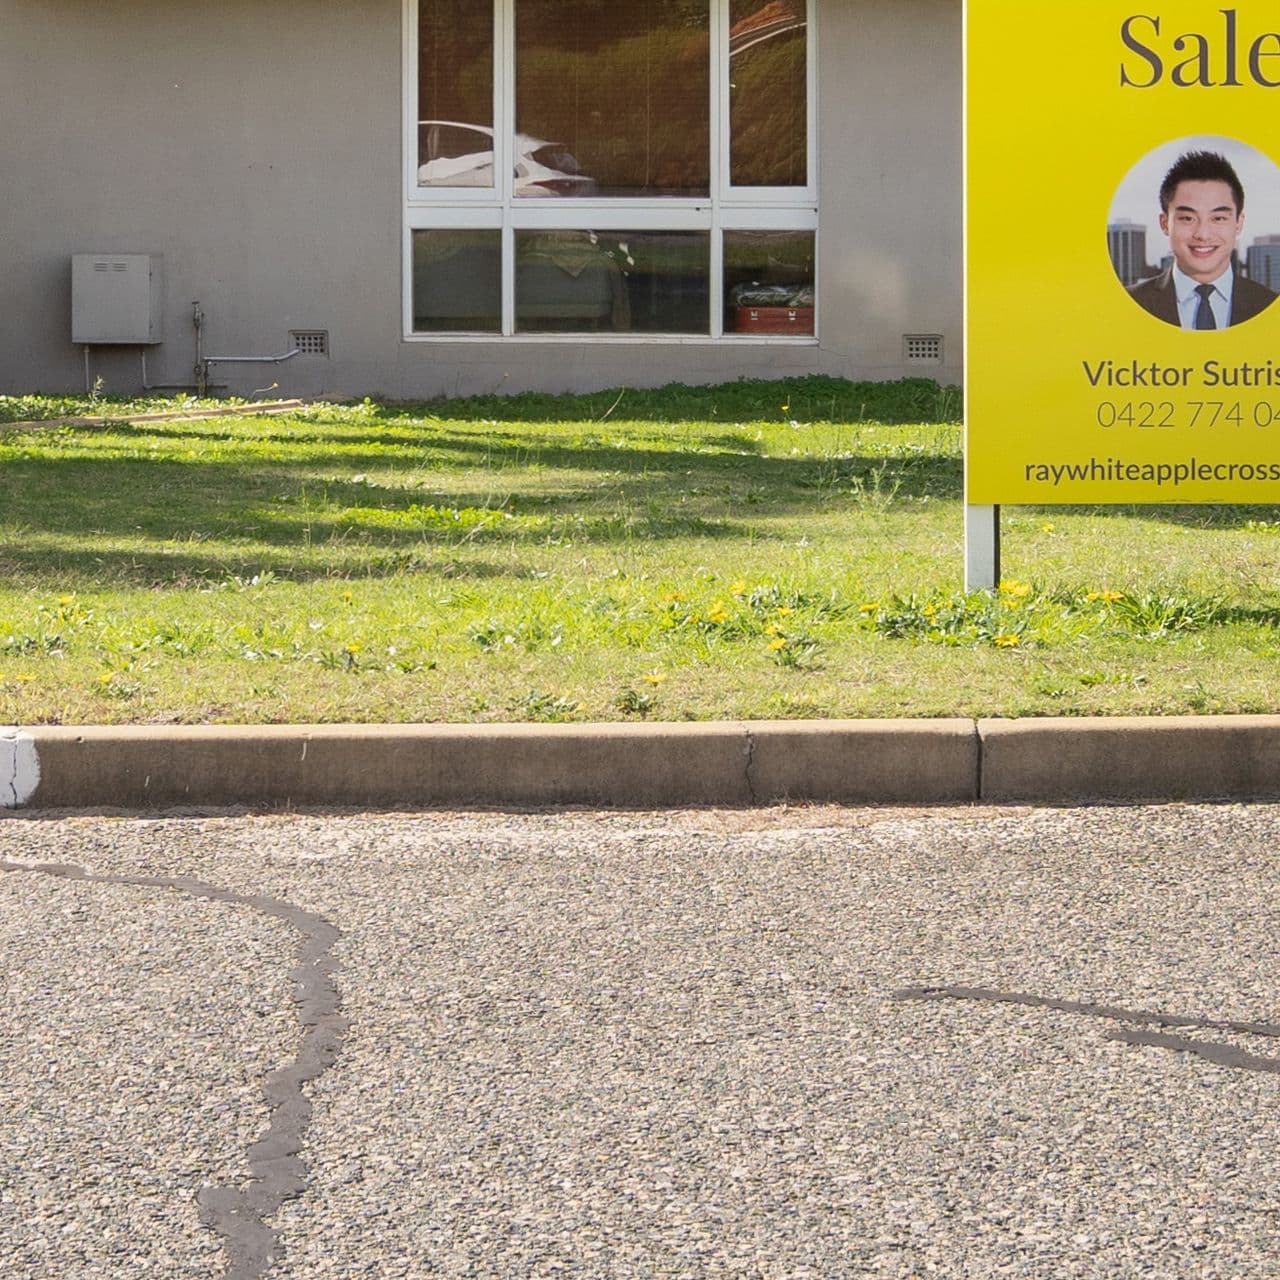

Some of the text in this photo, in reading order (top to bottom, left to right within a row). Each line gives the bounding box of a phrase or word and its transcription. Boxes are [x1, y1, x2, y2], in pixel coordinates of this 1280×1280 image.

[1082, 360, 1194, 387] Vicktor
[1097, 401, 1176, 428] 0422
[1186, 401, 1245, 428] 774
